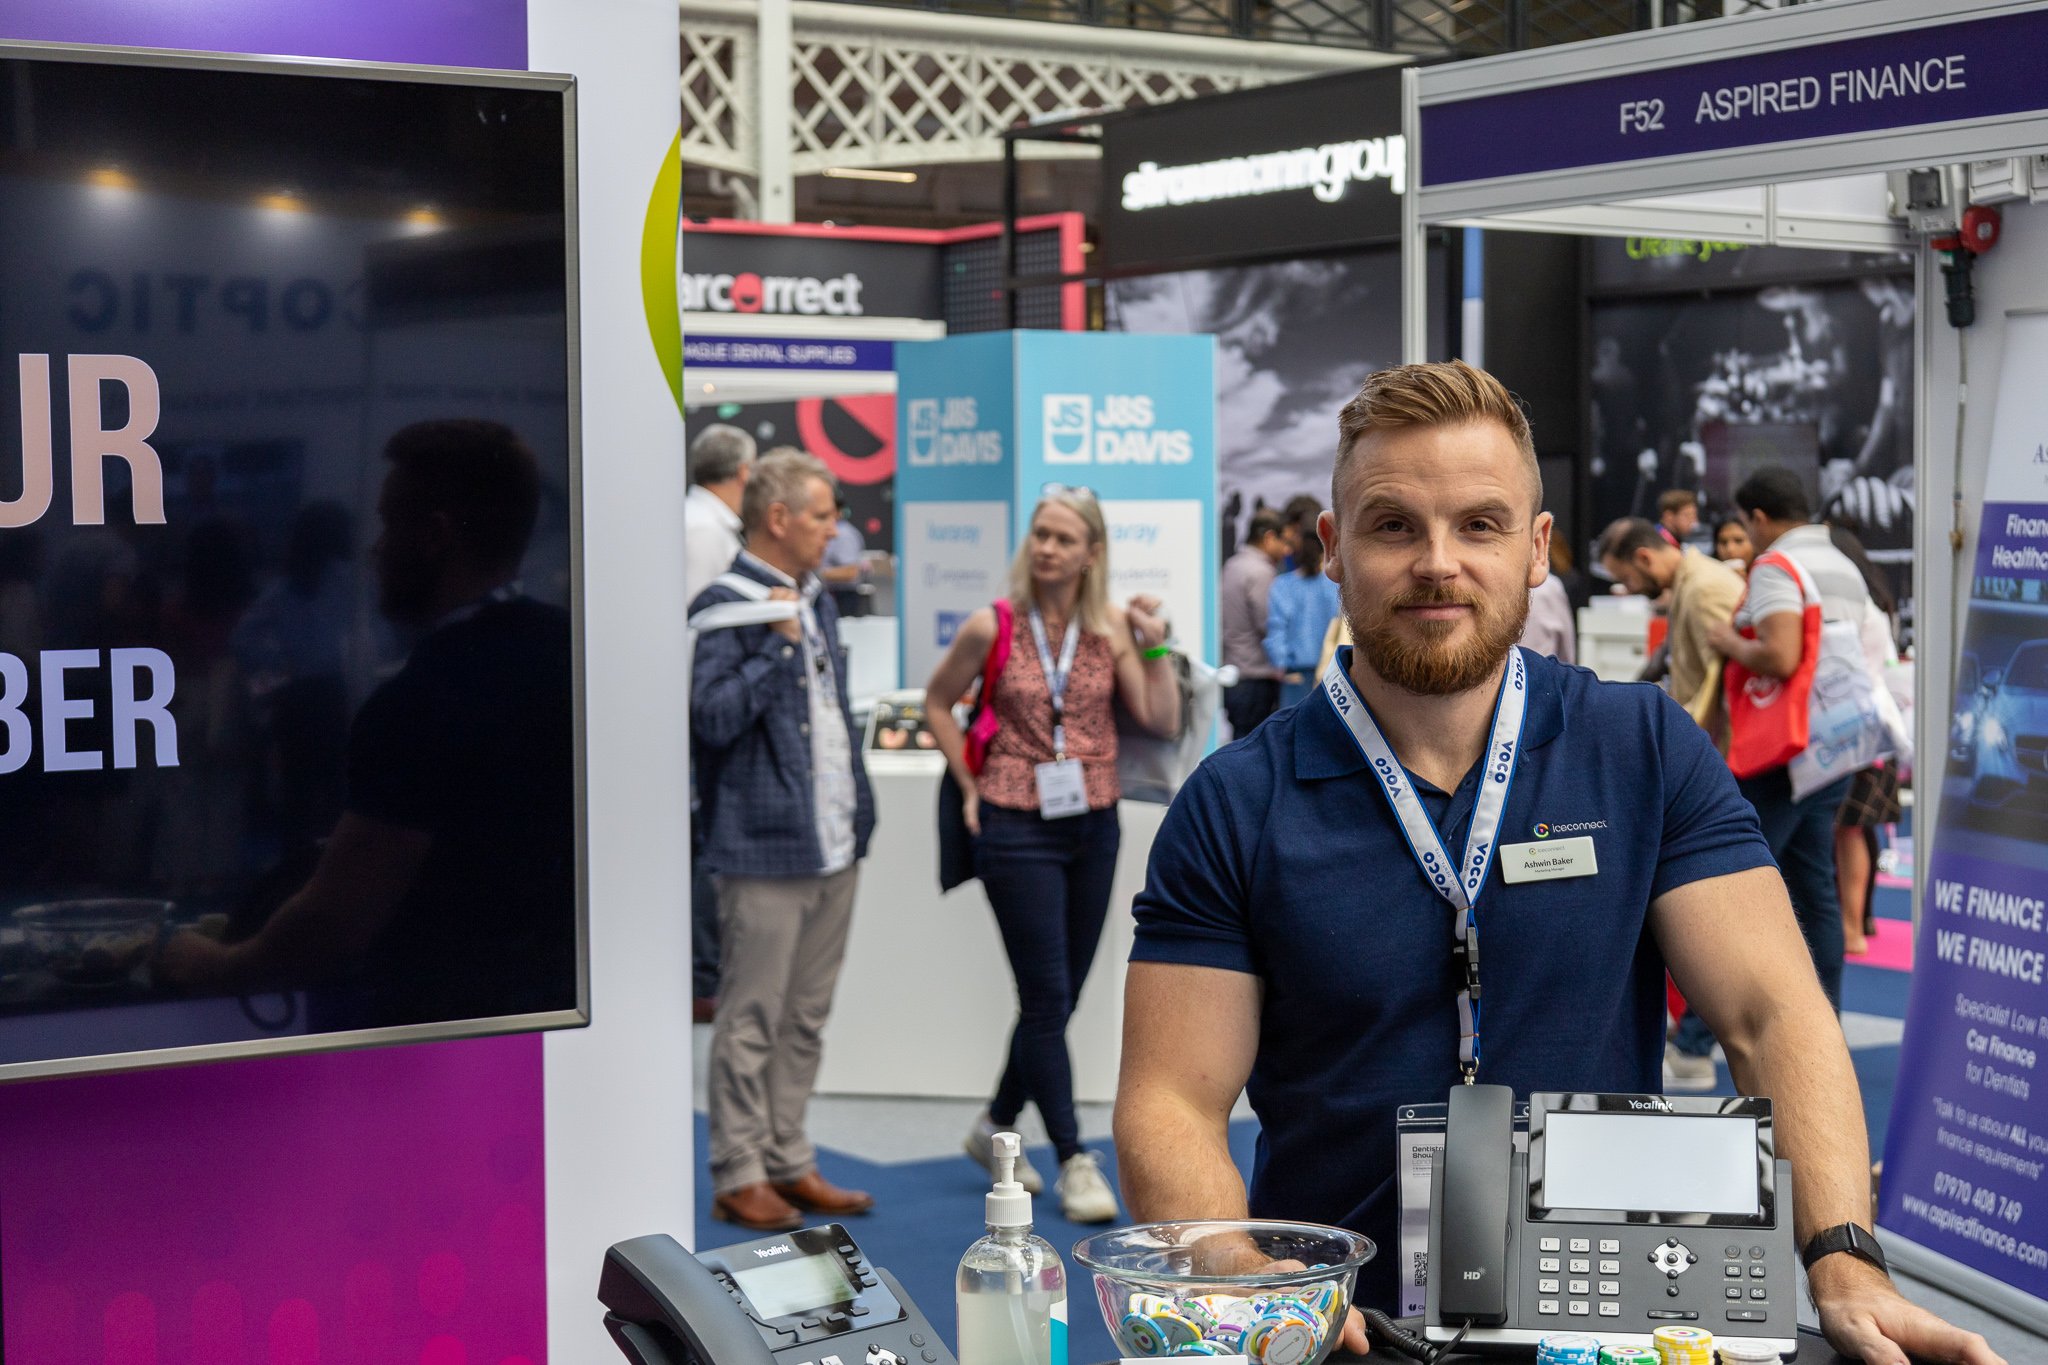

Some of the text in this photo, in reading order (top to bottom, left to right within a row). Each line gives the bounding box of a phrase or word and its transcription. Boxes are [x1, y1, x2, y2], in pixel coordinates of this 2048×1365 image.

[1619, 54, 1967, 134] F52 ASPIRED FINANCE
[729, 342, 785, 364] DENTAL
[784, 344, 857, 366] SUPPLIES
[1095, 430, 1193, 466] DAVIS
[1514, 656, 1524, 691] VOCO
[1330, 682, 1351, 715] VOCO
[1375, 757, 1401, 798] VOCO
[1494, 740, 1514, 784] VOCO
[1552, 819, 1607, 833] iceconnect
[1423, 851, 1450, 897] VOCO
[1468, 843, 1489, 888] VOCO
[1523, 856, 1574, 869] Ashwin Baker
[1935, 878, 2046, 933] WE FINANCE
[1936, 928, 2046, 985] WE FINANCE
[2010, 1007, 2038, 1036] Low
[1965, 1027, 2037, 1070] Car Finance
[1965, 1060, 2031, 1102] for Dentists
[1628, 1099, 1673, 1111] Yealink
[1954, 1104, 1967, 1127] to
[1967, 1112, 1979, 1131] us
[2008, 1124, 2028, 1148] ALL
[1933, 1171, 1972, 1206] 07970
[1997, 1195, 2024, 1225] 749
[752, 1243, 792, 1259] Yealink
[1463, 1271, 1481, 1280] HD
